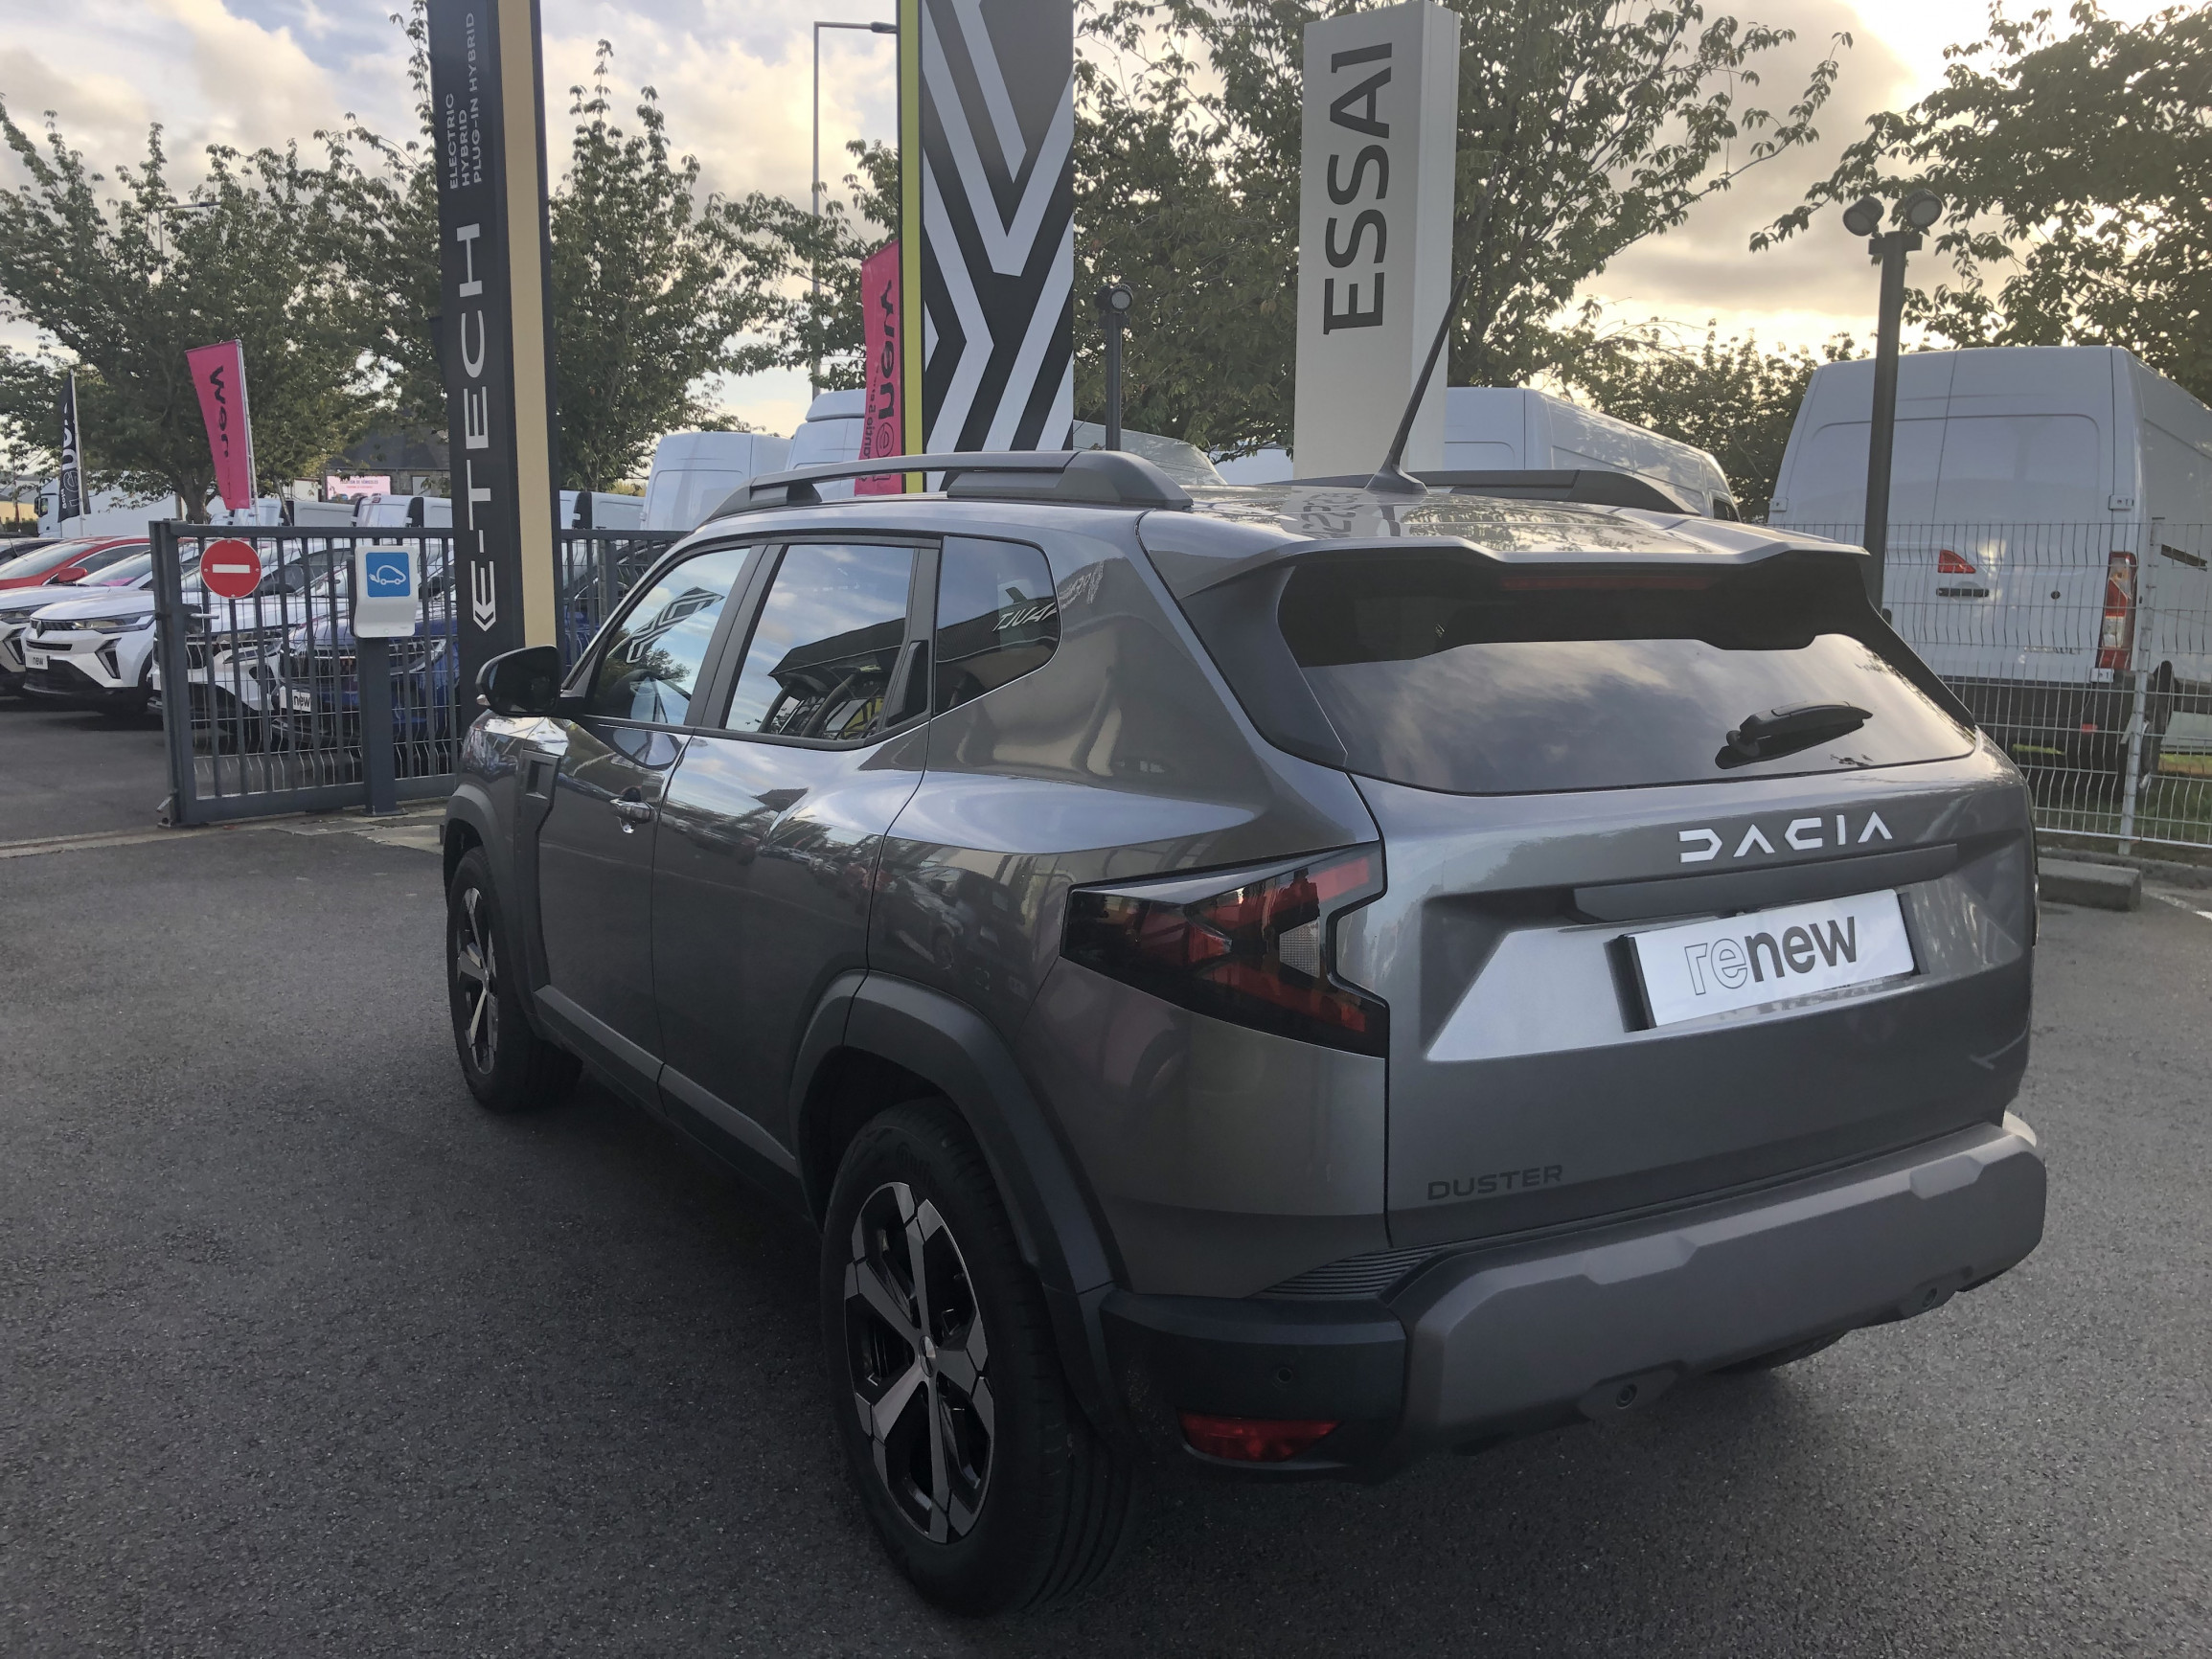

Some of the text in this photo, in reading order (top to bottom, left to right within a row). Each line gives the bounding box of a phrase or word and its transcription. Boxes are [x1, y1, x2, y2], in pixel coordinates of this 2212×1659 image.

[445, 93, 459, 189] ELECTRIC
[466, 12, 482, 184] PLUG-IN HYBRID
[459, 109, 470, 186] HYBRID
[1323, 42, 1393, 334] ESSAI
[456, 223, 496, 632] E-TECH
[1678, 811, 1893, 863] DACIA
[1684, 916, 1857, 995] renew
[1427, 1165, 1562, 1200] DUSTER
